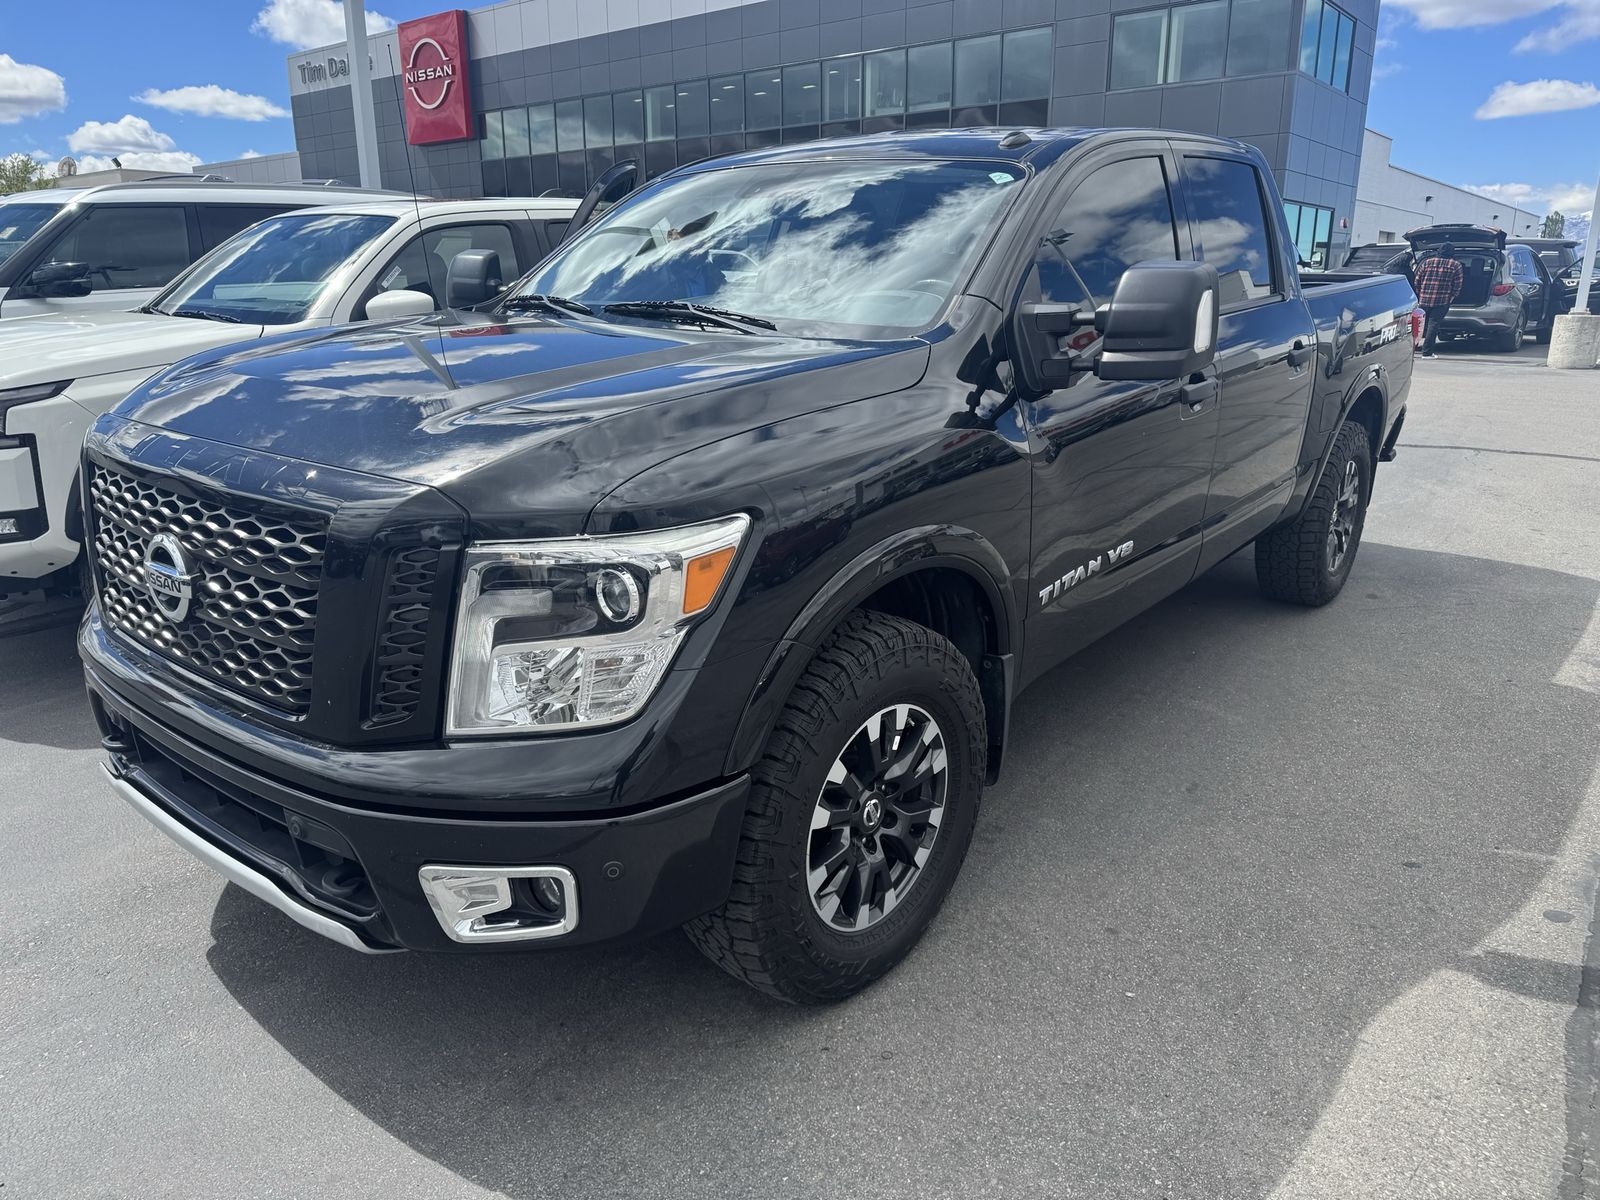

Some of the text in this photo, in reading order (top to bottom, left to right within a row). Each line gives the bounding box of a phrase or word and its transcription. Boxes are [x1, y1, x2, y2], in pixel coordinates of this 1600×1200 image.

[297, 61, 326, 84] Tim
[405, 64, 453, 83] NISSAN
[1038, 540, 1134, 606] TITAN V8
